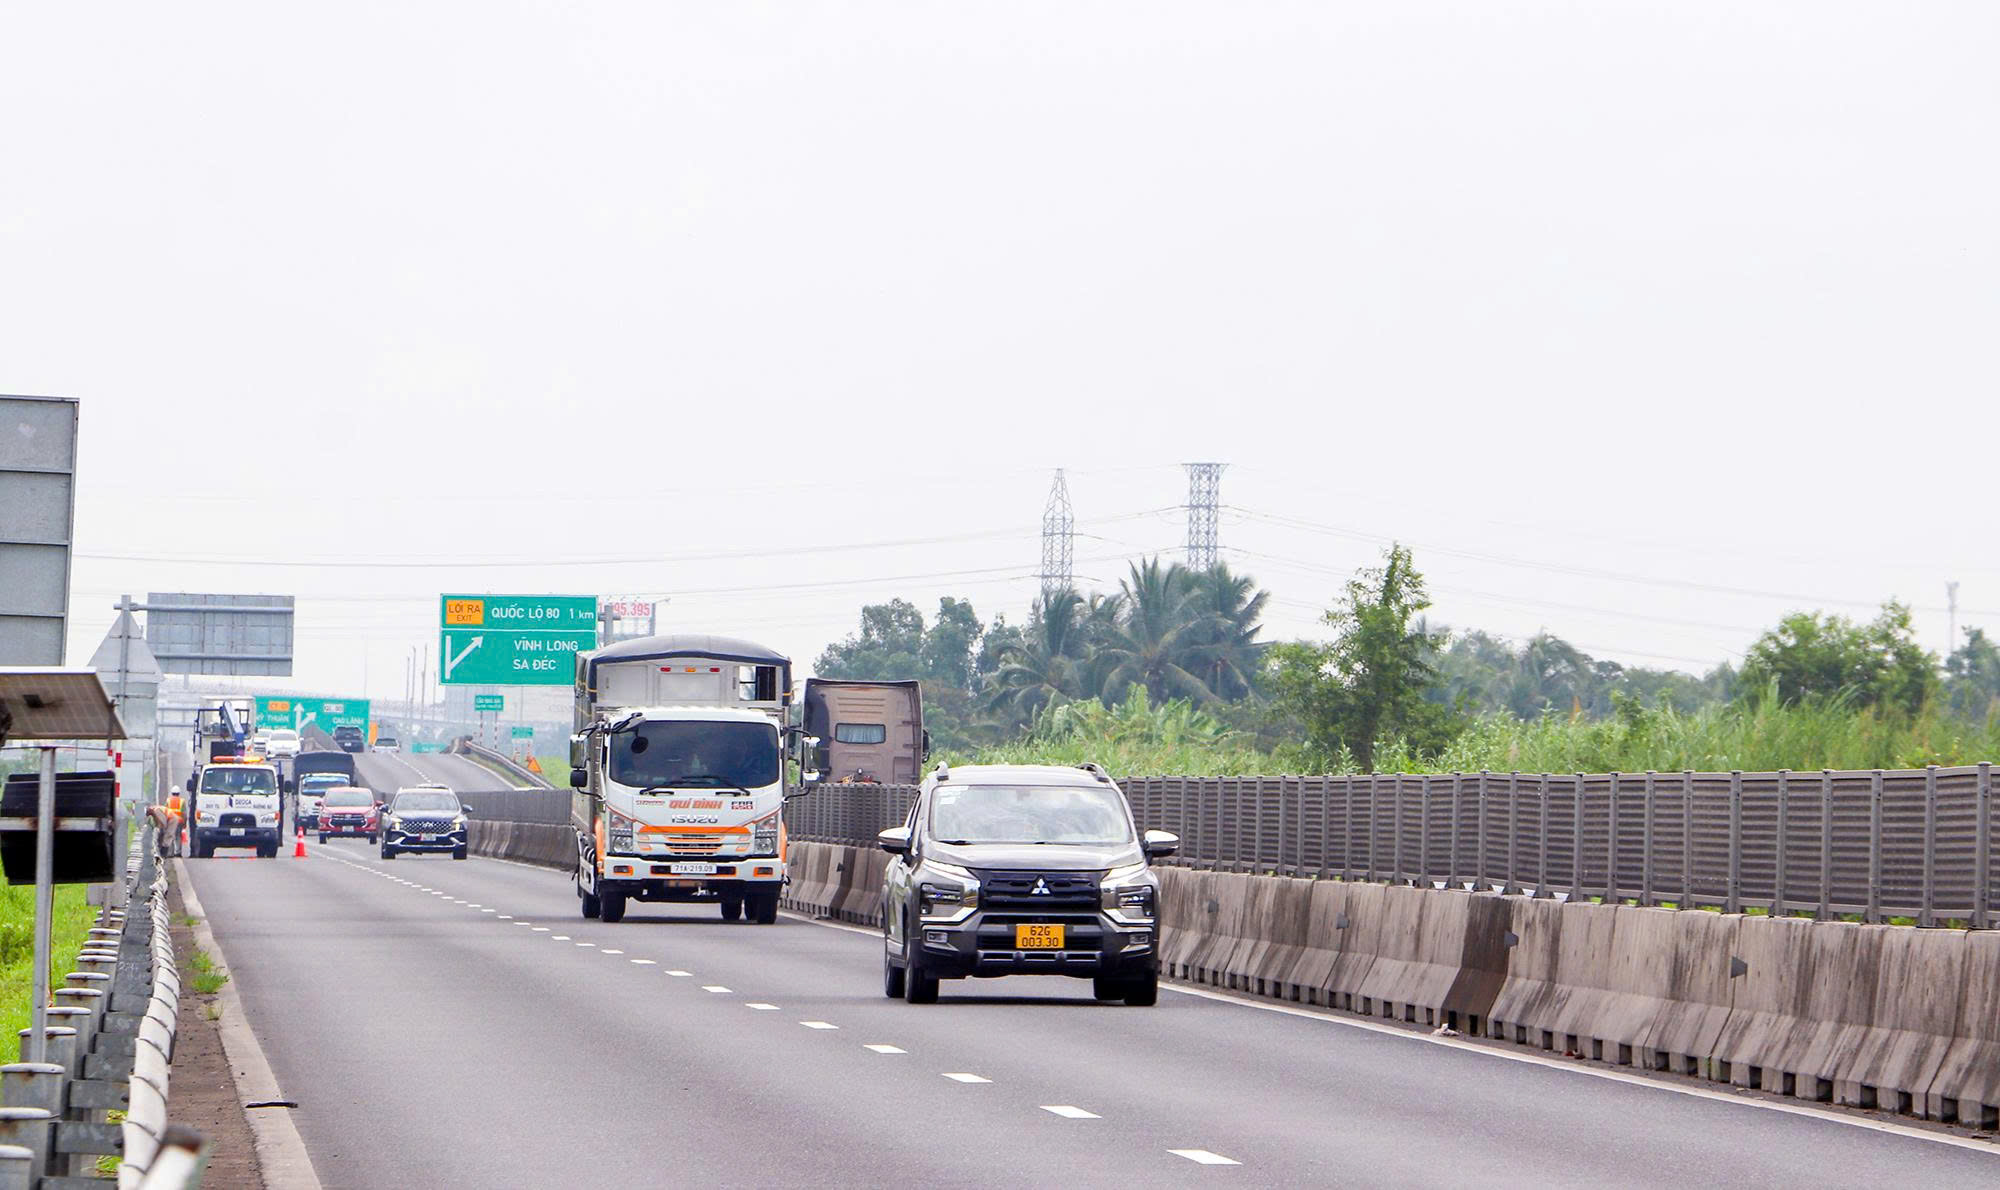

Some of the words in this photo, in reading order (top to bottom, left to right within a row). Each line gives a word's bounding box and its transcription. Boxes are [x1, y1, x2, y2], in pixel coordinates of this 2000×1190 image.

[448, 601, 464, 613] LỐI
[467, 604, 481, 613] RA
[491, 603, 525, 619] QUỐC
[528, 605, 543, 621] LỘ
[546, 607, 560, 619] 80
[569, 607, 574, 619] 1
[578, 608, 594, 619] km
[456, 614, 472, 622] EXIT
[514, 636, 542, 651] VĨNH
[546, 639, 579, 652] LONG
[512, 659, 530, 670] SA
[532, 655, 557, 671] ĐÉC
[671, 813, 719, 824] ISUZU
[1030, 926, 1051, 936] 62G
[1021, 937, 1059, 947] 003.30
